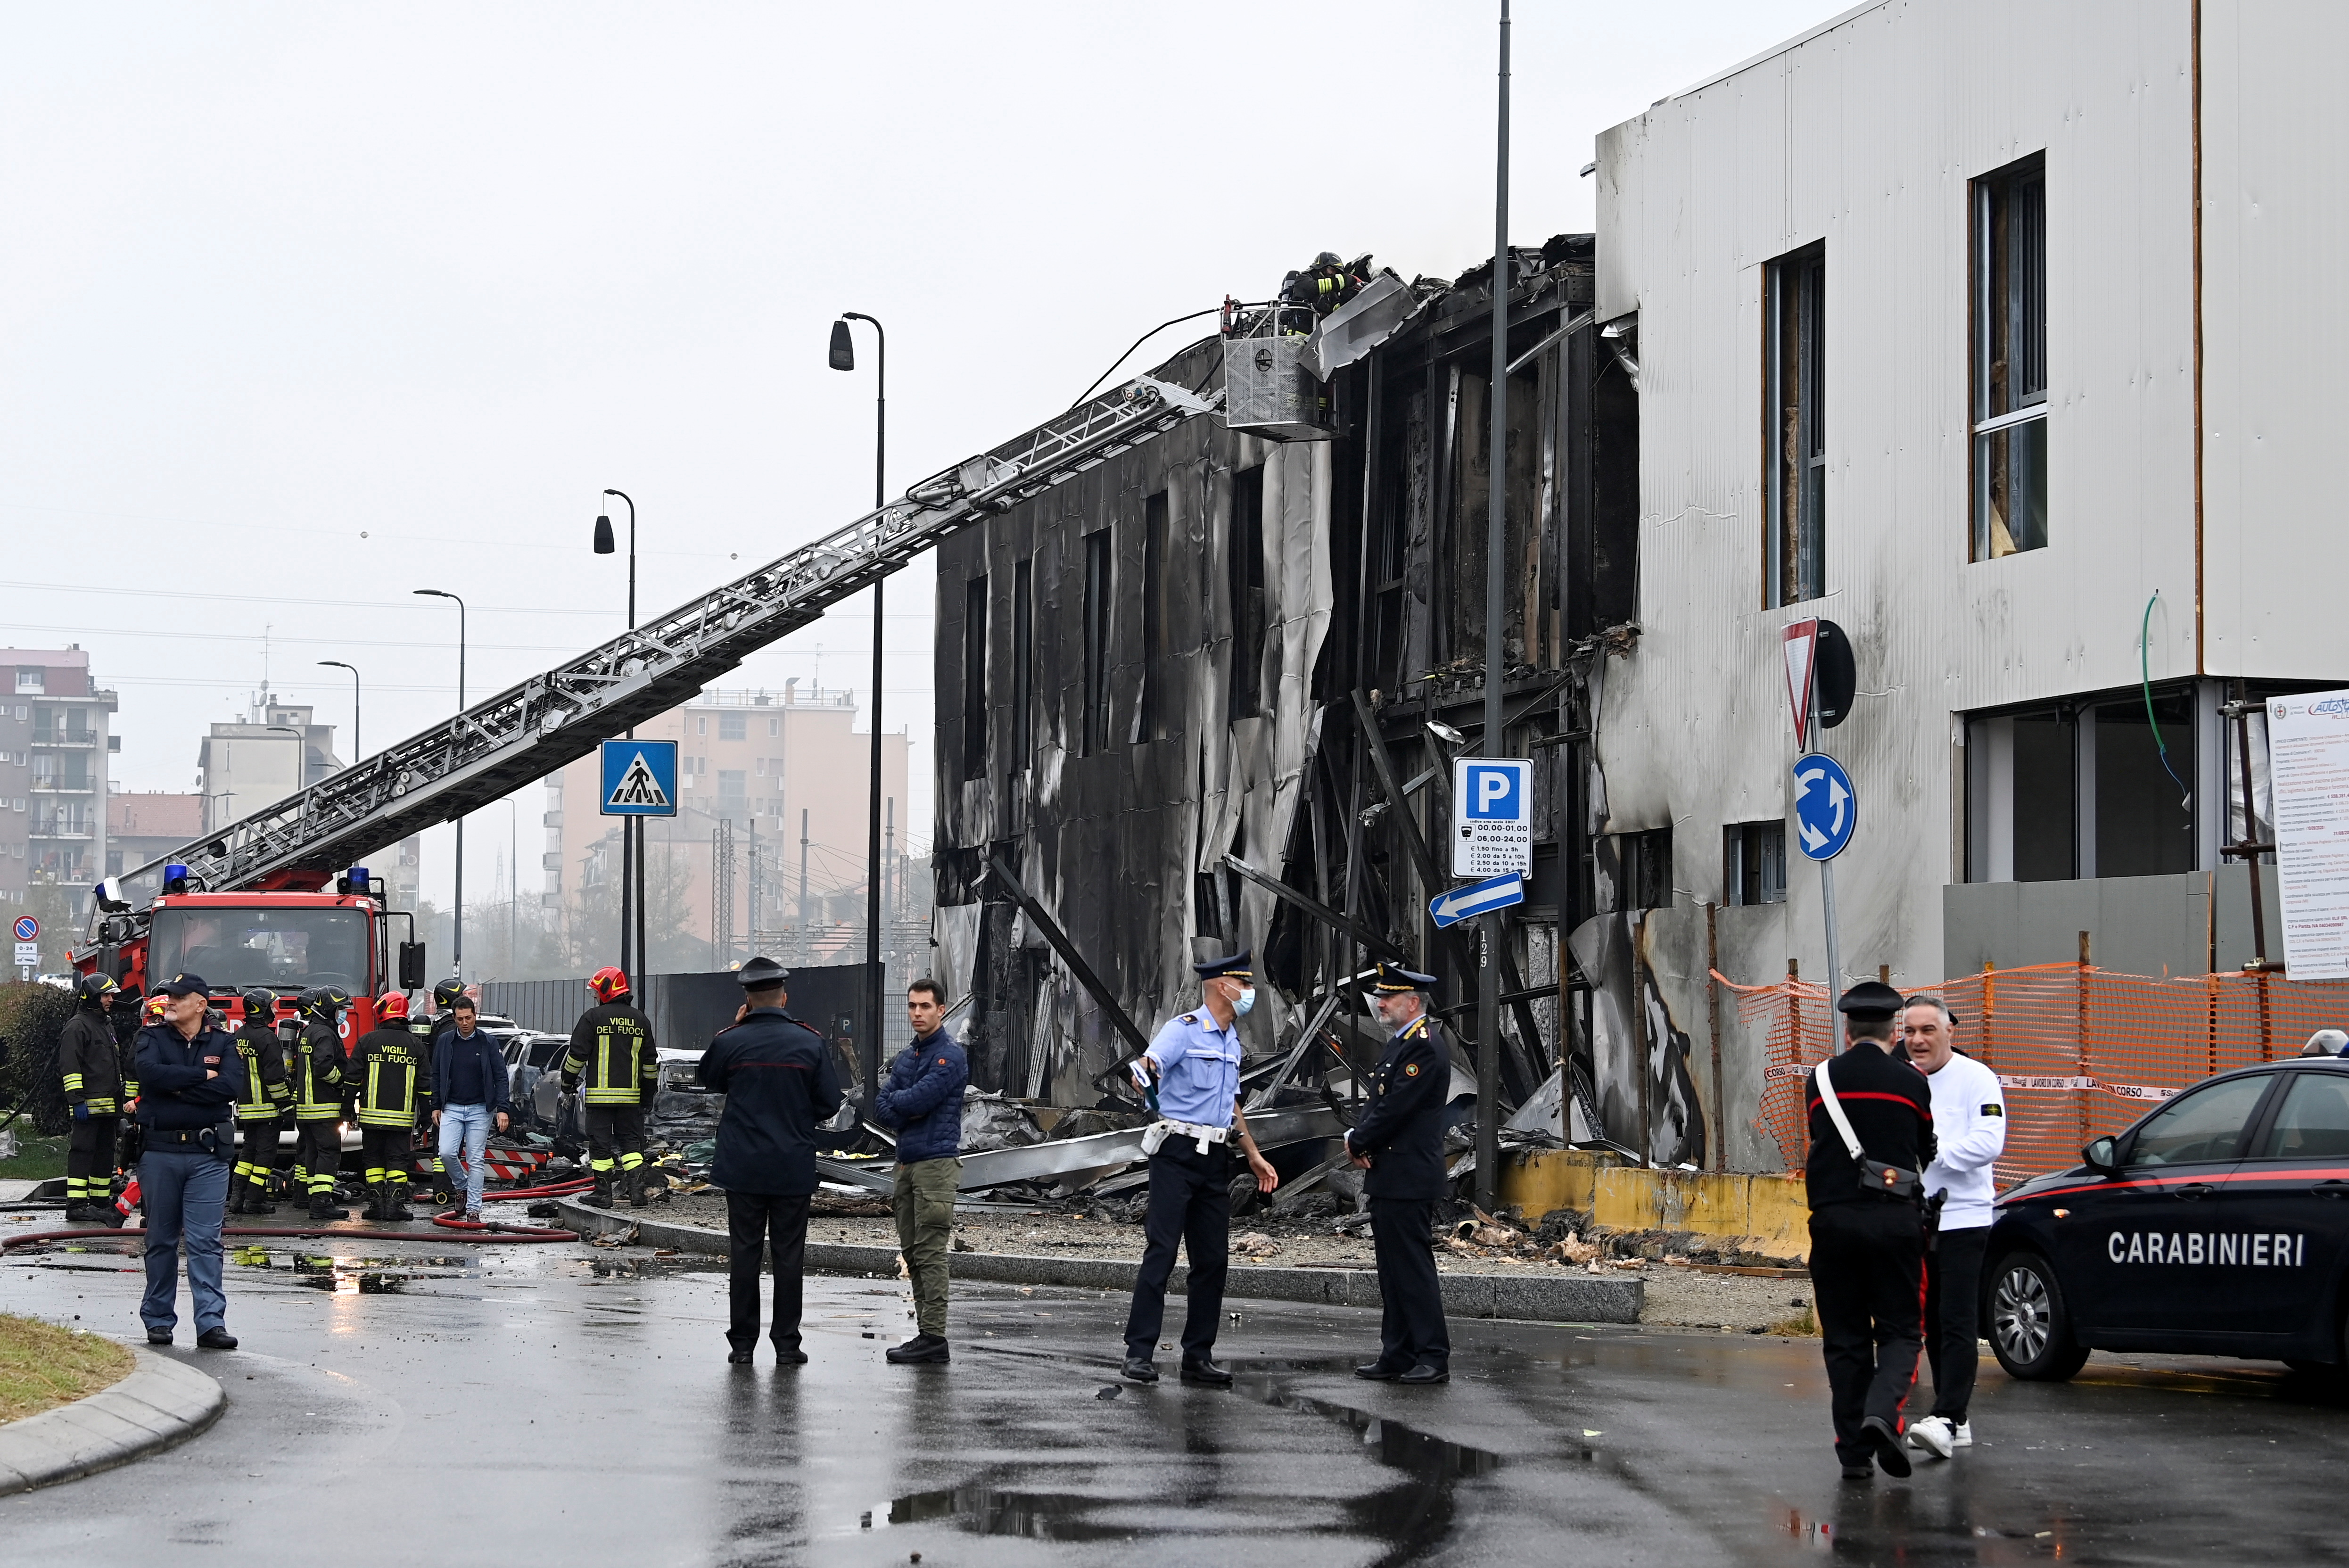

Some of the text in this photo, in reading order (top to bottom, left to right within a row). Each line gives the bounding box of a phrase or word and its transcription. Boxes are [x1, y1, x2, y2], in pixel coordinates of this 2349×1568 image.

[1479, 772, 1510, 812] P
[609, 1017, 634, 1026] VIGILI
[843, 1019, 850, 1030] P
[596, 1025, 614, 1034] DEL
[381, 1045, 407, 1055] VIGILI
[368, 1054, 385, 1062] DEL
[1766, 1067, 1786, 1078] CORSO
[2031, 1078, 2046, 1088] LAVORI
[2117, 1086, 2142, 1098] CORSO
[2108, 1231, 2303, 1267] CARABINIERI
